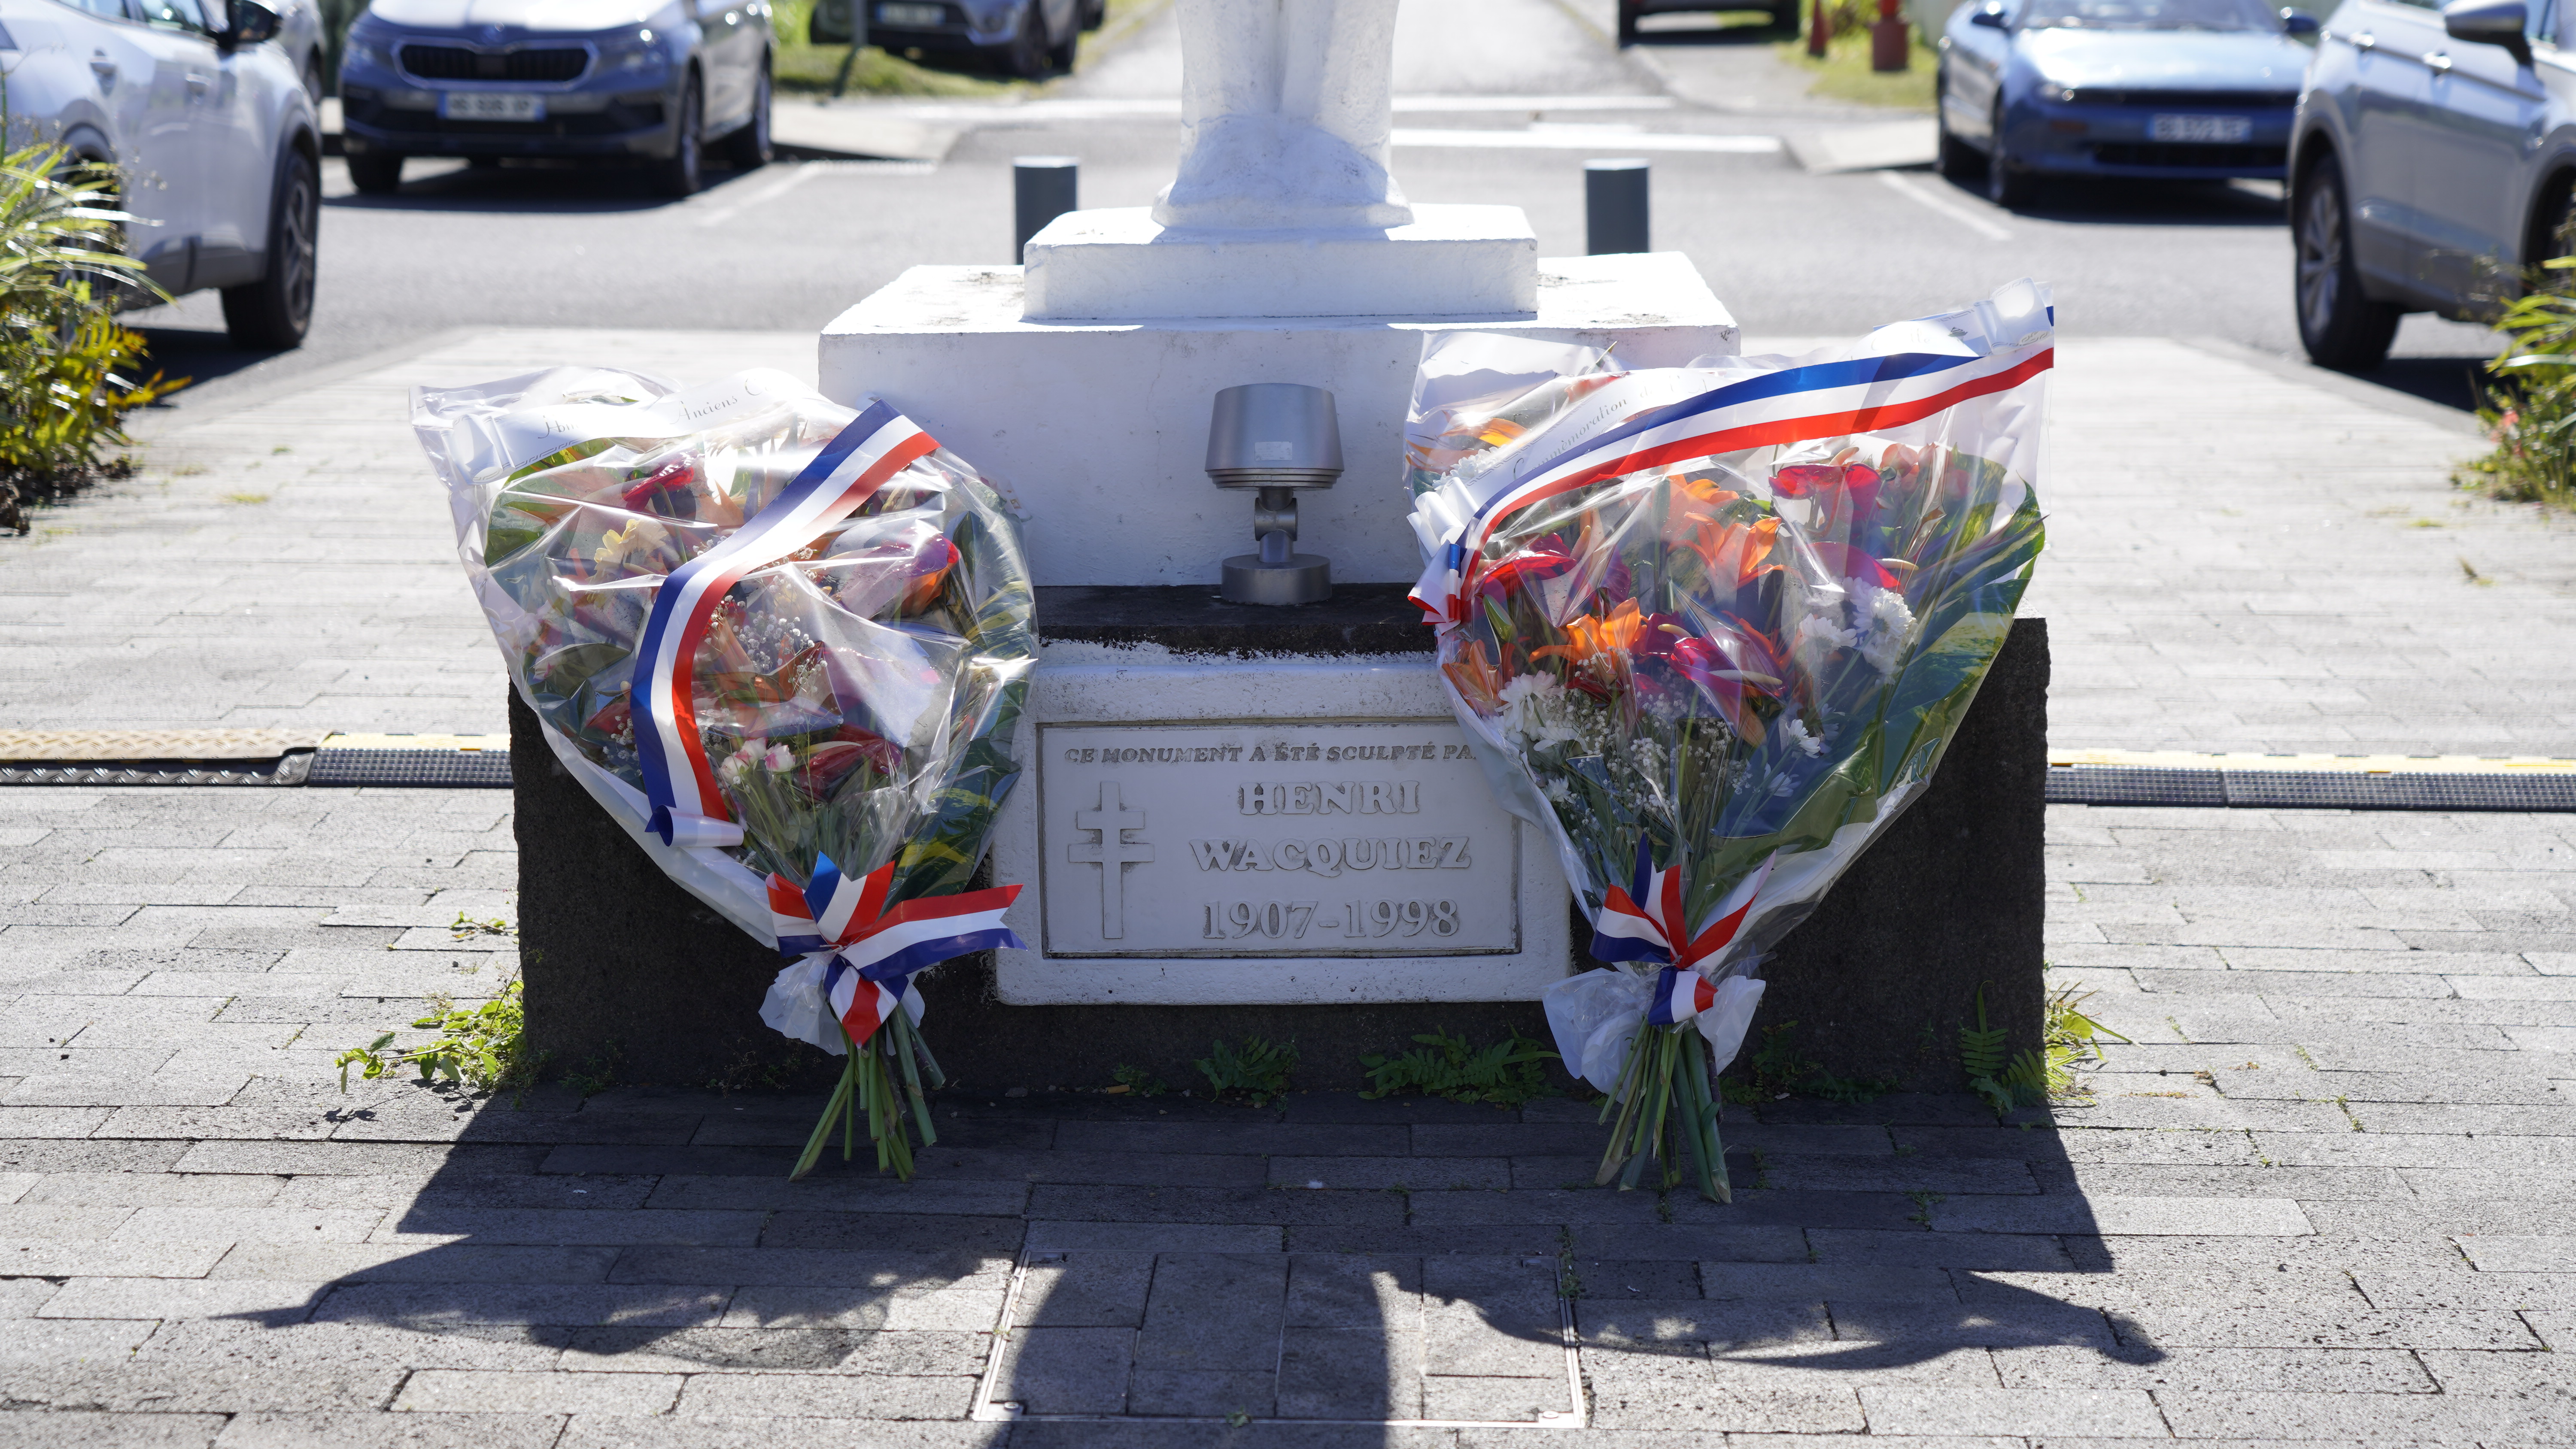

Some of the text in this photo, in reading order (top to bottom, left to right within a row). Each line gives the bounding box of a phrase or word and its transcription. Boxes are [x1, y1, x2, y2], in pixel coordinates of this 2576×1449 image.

[670, 396, 738, 424] Anciens
[1064, 741, 1476, 763] CE MONUMENT A ÉTÉ SCULPTÉ PA
[1238, 780, 1420, 815] HENRI
[1189, 835, 1472, 878] WACQUIEZ
[1203, 898, 1459, 939] 1907-1998
